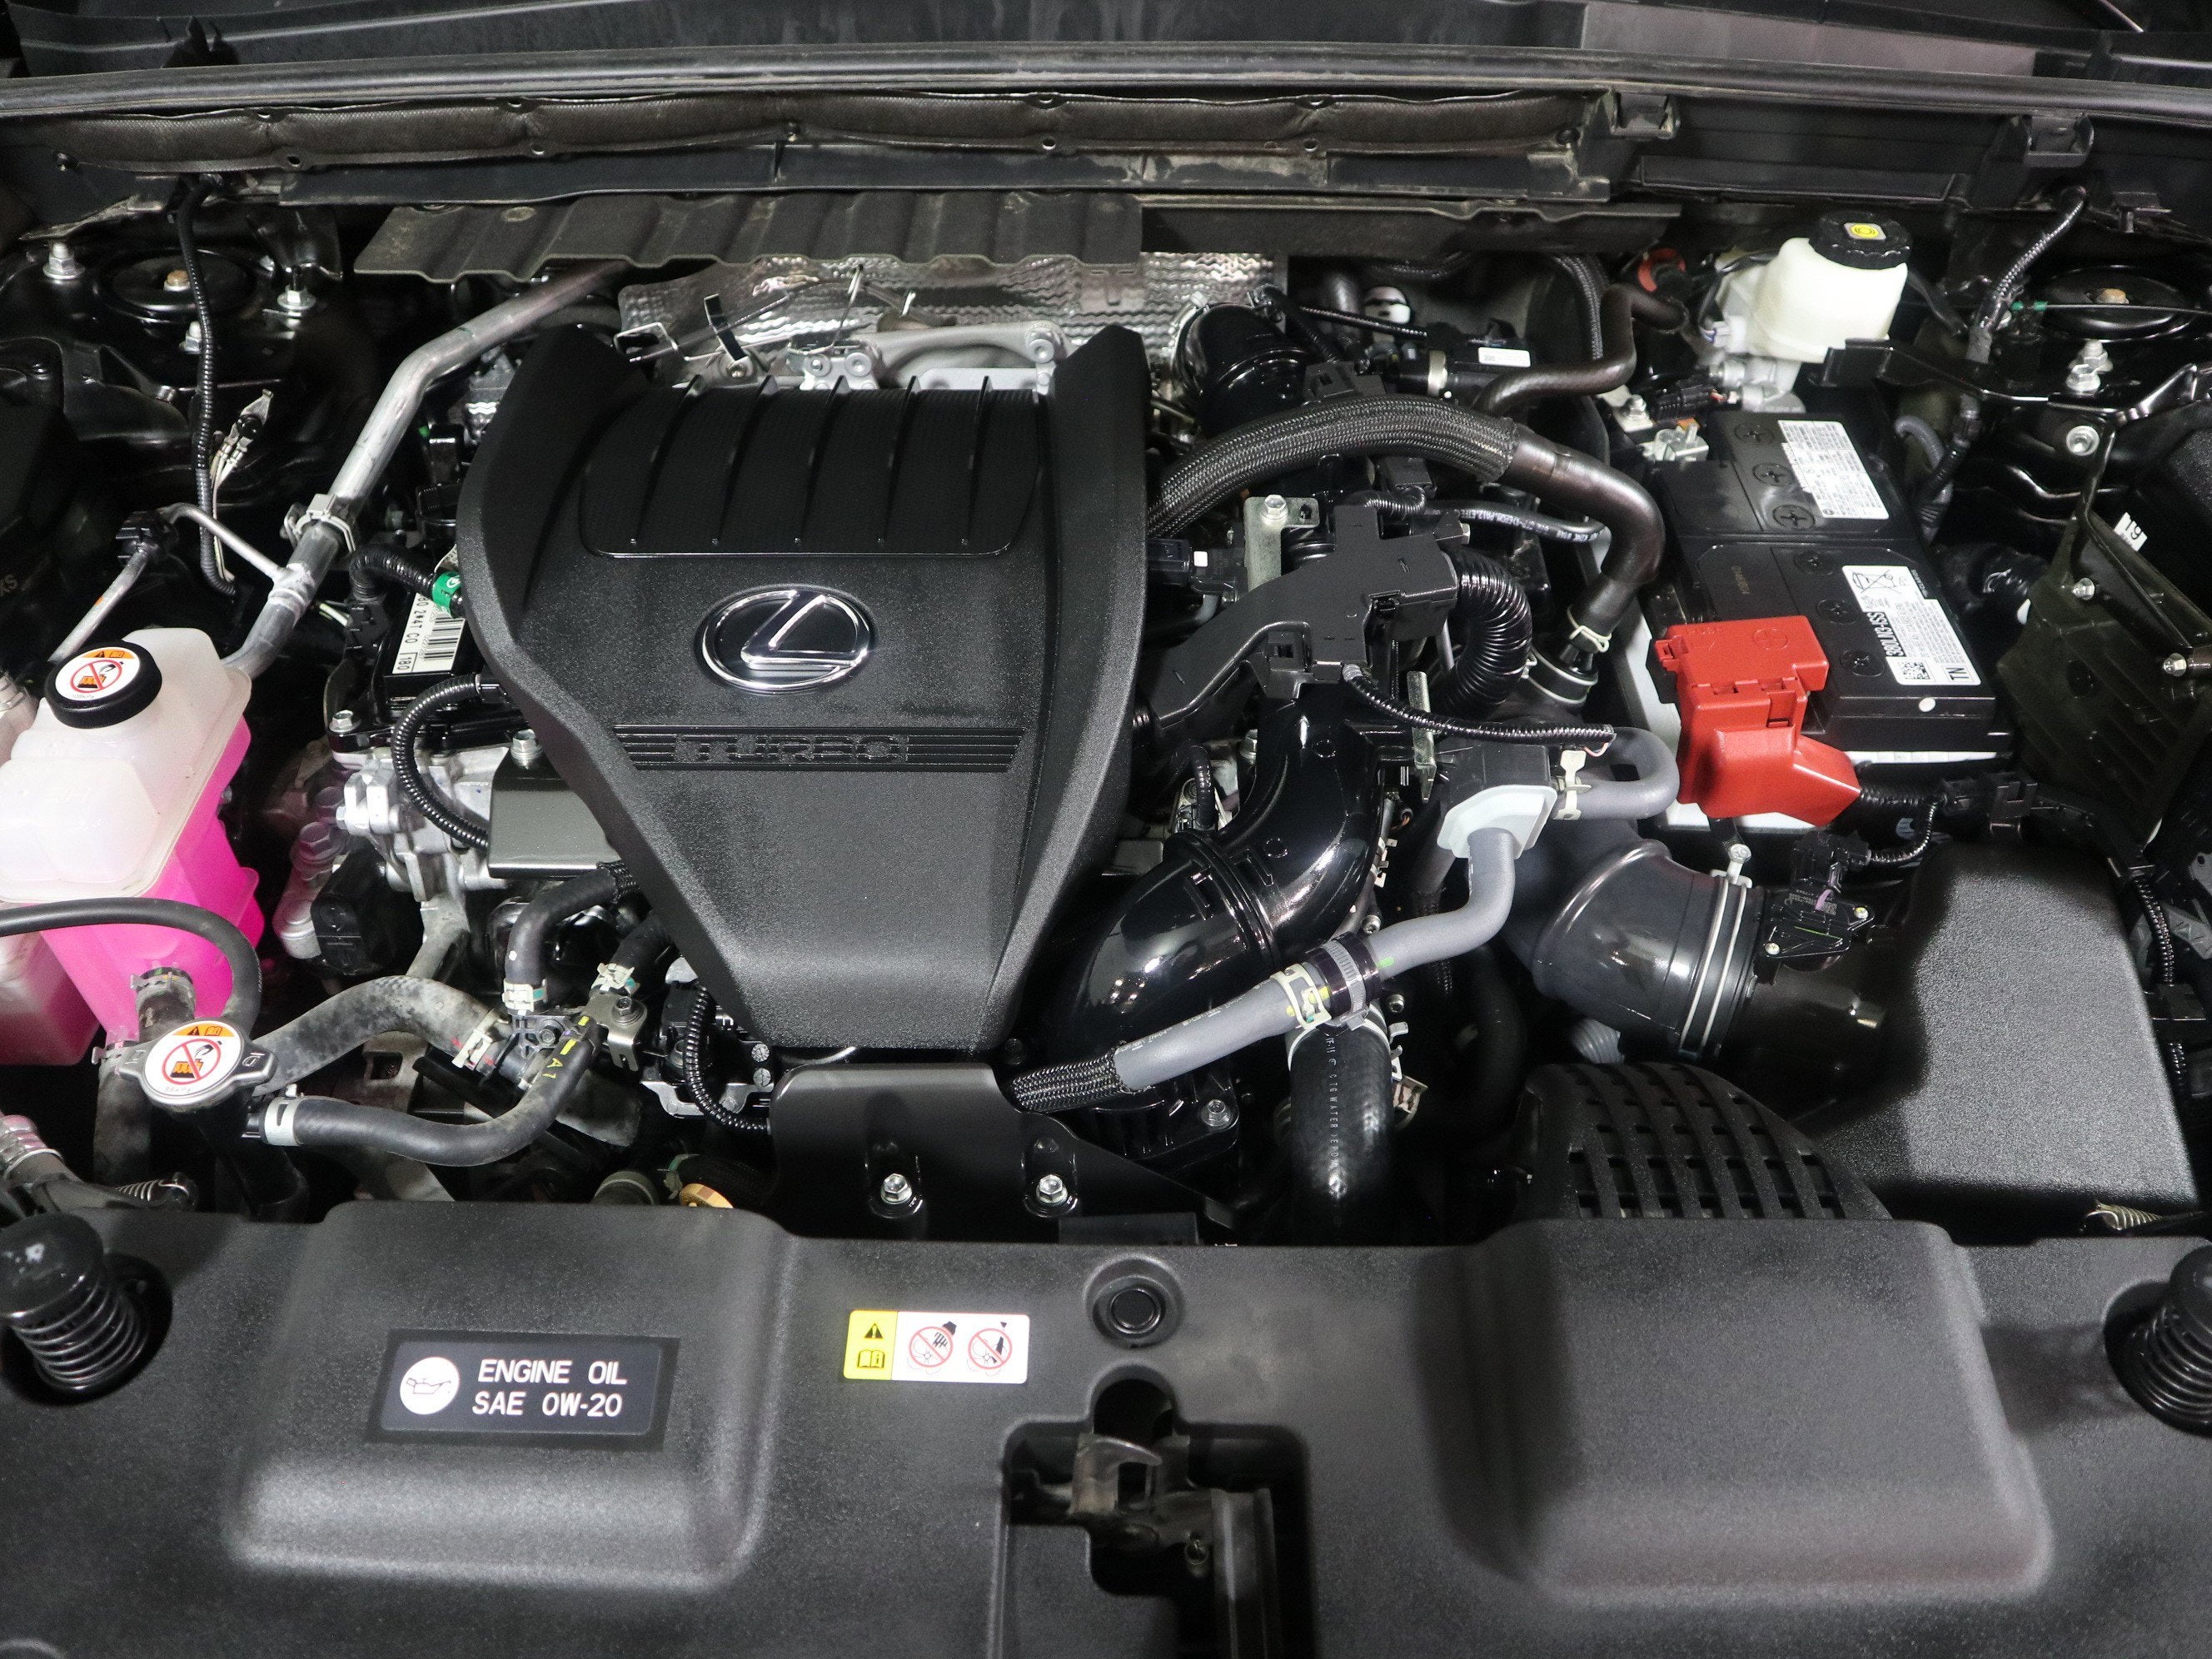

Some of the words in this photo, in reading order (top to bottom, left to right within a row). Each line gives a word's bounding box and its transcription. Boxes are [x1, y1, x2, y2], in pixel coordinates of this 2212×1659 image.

[397, 656, 411, 670] 180
[1946, 667, 1970, 680] TN
[681, 734, 902, 762] TURBO
[1329, 1096, 1339, 1128] WATER
[477, 1358, 573, 1385] ENGINE
[587, 1360, 628, 1386] OIL
[472, 1391, 526, 1416] SAE
[541, 1392, 624, 1417] 0W-20
